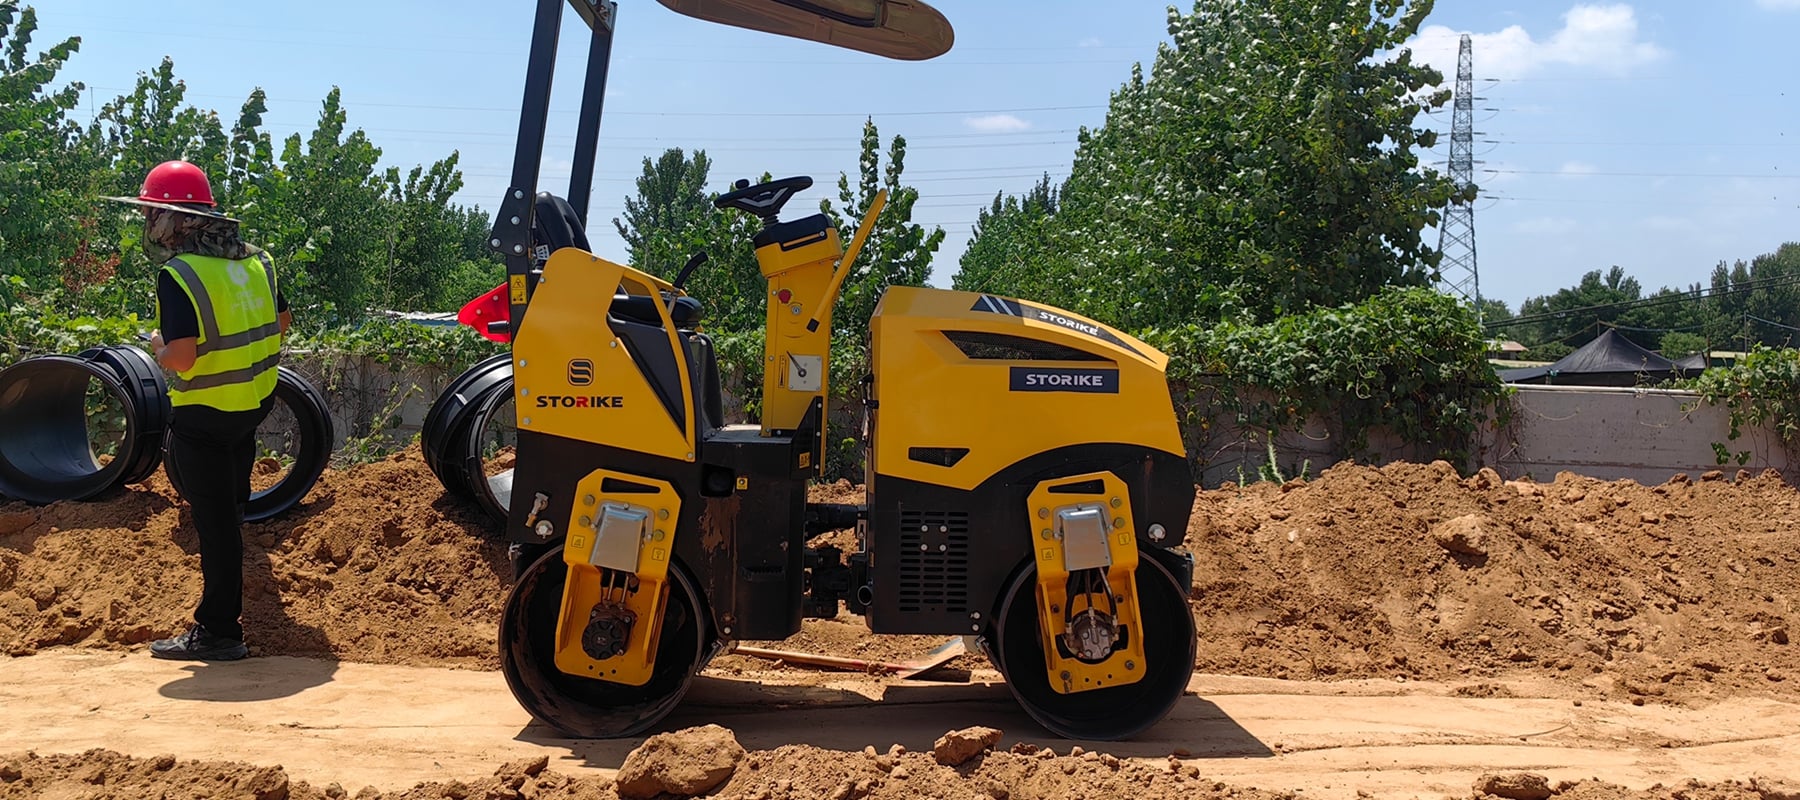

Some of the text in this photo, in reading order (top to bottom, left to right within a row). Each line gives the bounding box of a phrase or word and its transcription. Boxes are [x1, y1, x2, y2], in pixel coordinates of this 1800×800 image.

[1039, 311, 1099, 336] STORIKE
[1026, 373, 1103, 386] STORIKE
[536, 395, 623, 408] STORIKE
